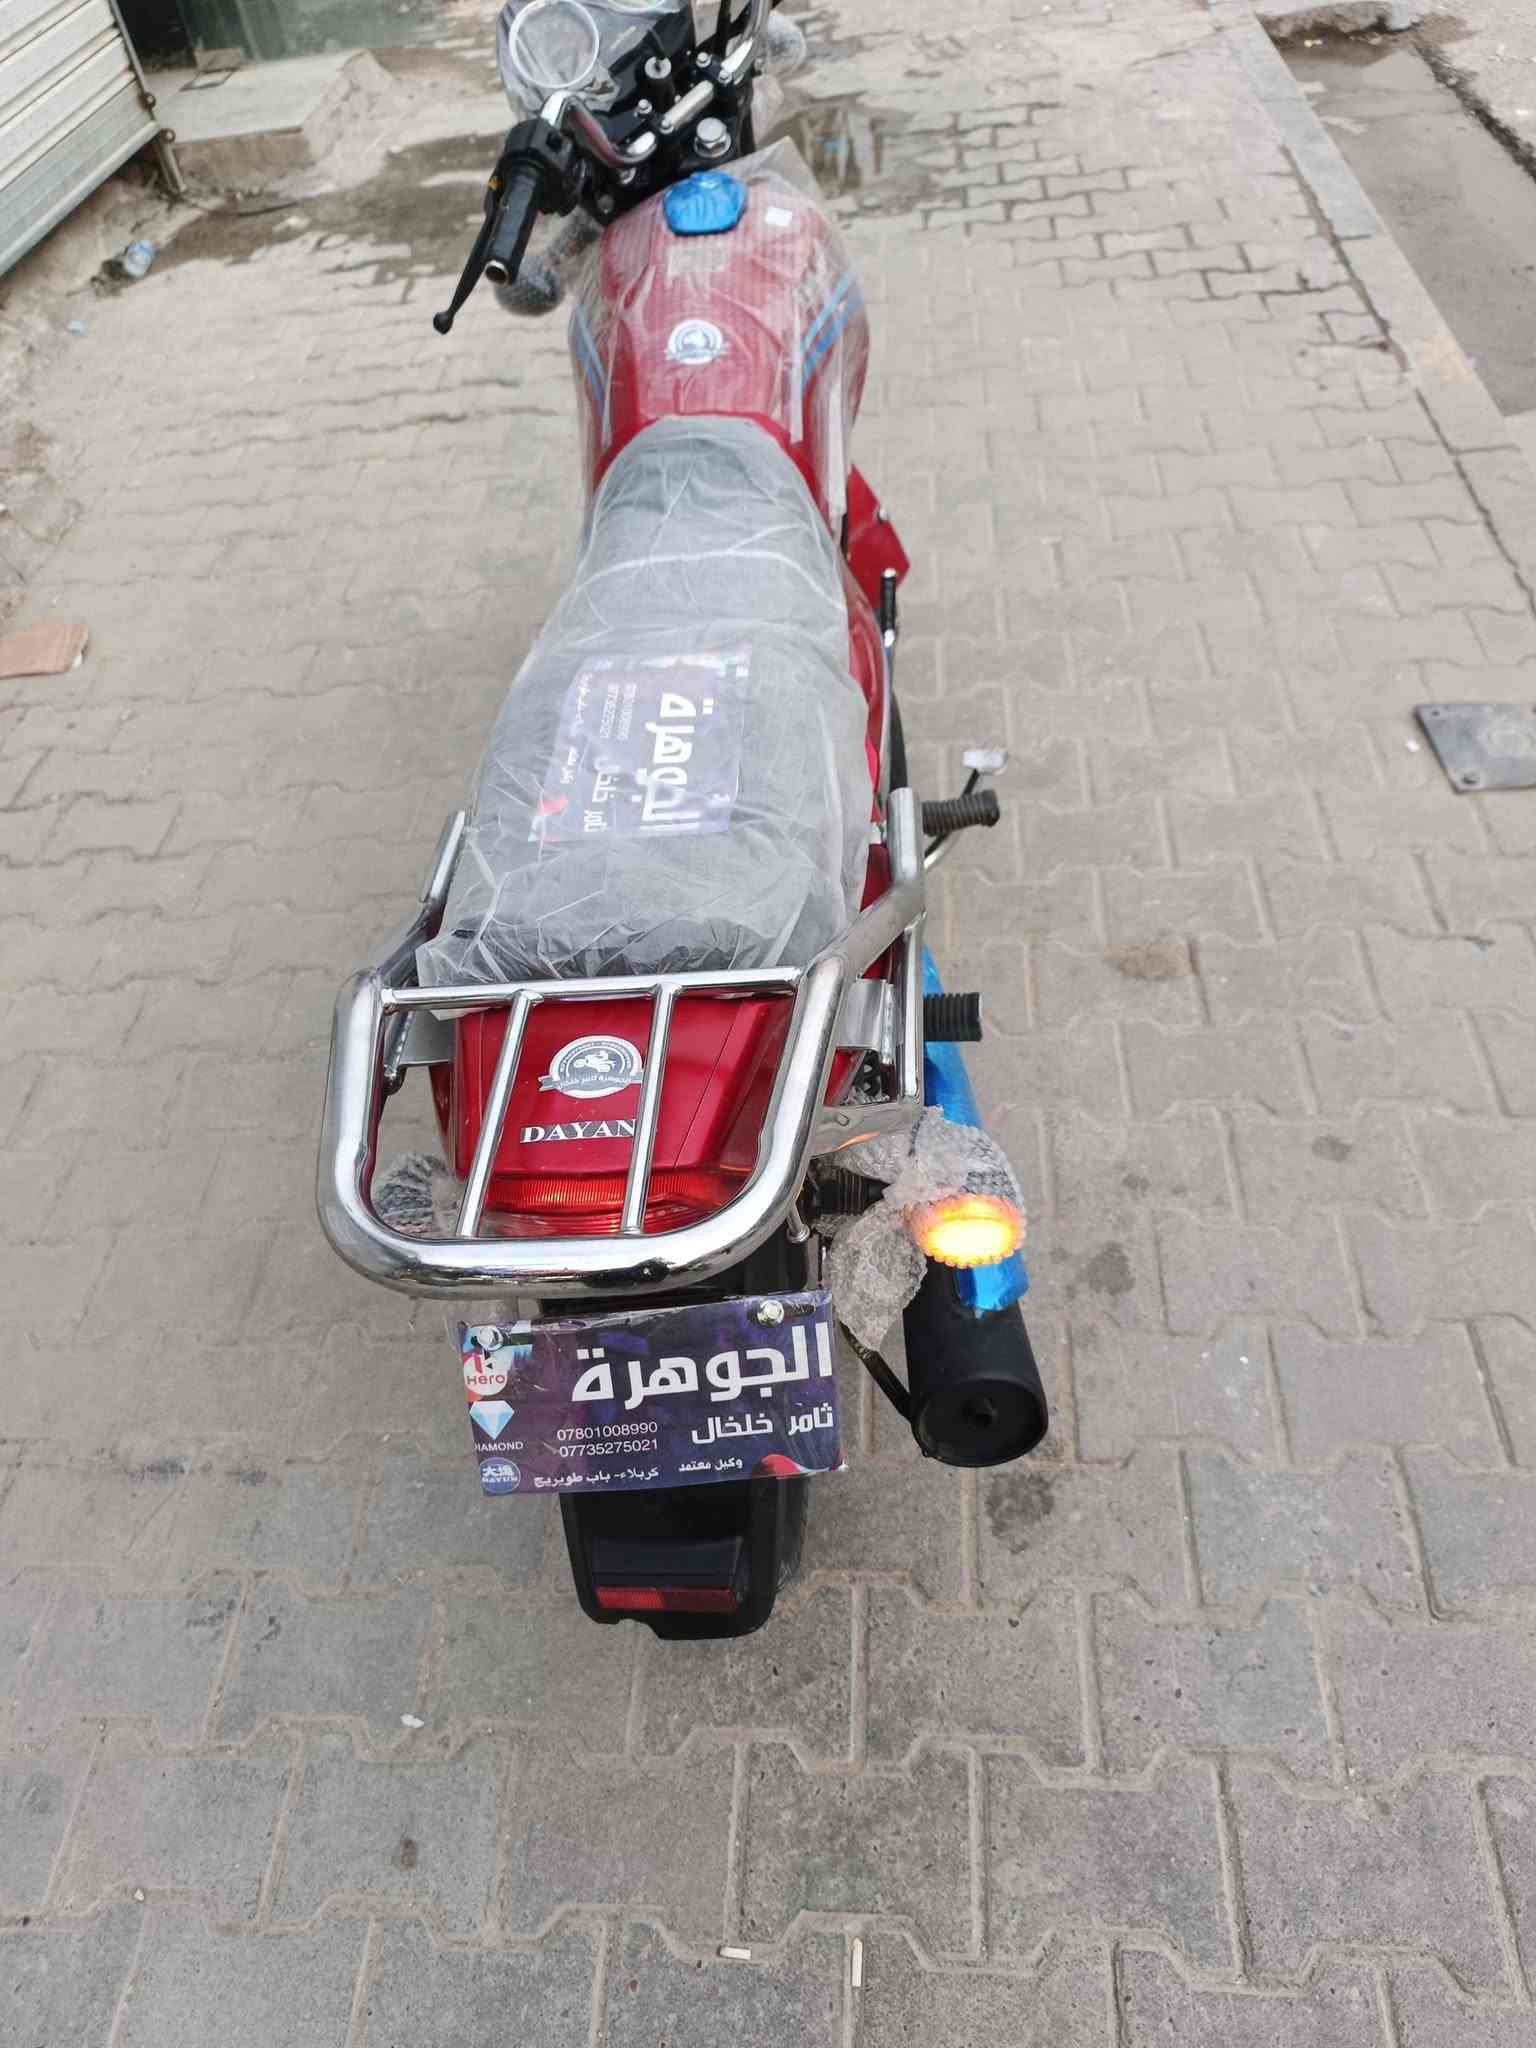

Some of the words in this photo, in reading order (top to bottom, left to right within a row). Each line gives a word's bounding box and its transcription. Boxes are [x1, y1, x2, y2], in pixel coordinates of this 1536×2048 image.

[571, 1321, 833, 1411] الجوهرة
[466, 1374, 506, 1385] Hero
[691, 1413, 774, 1445] خلخال
[787, 1402, 834, 1436] ثامر
[556, 1421, 658, 1441] 07801008990
[559, 1438, 658, 1458] 07735275021
[678, 1460, 712, 1473] معتمد
[715, 1457, 744, 1471] وكيل
[586, 1469, 612, 1484] باب
